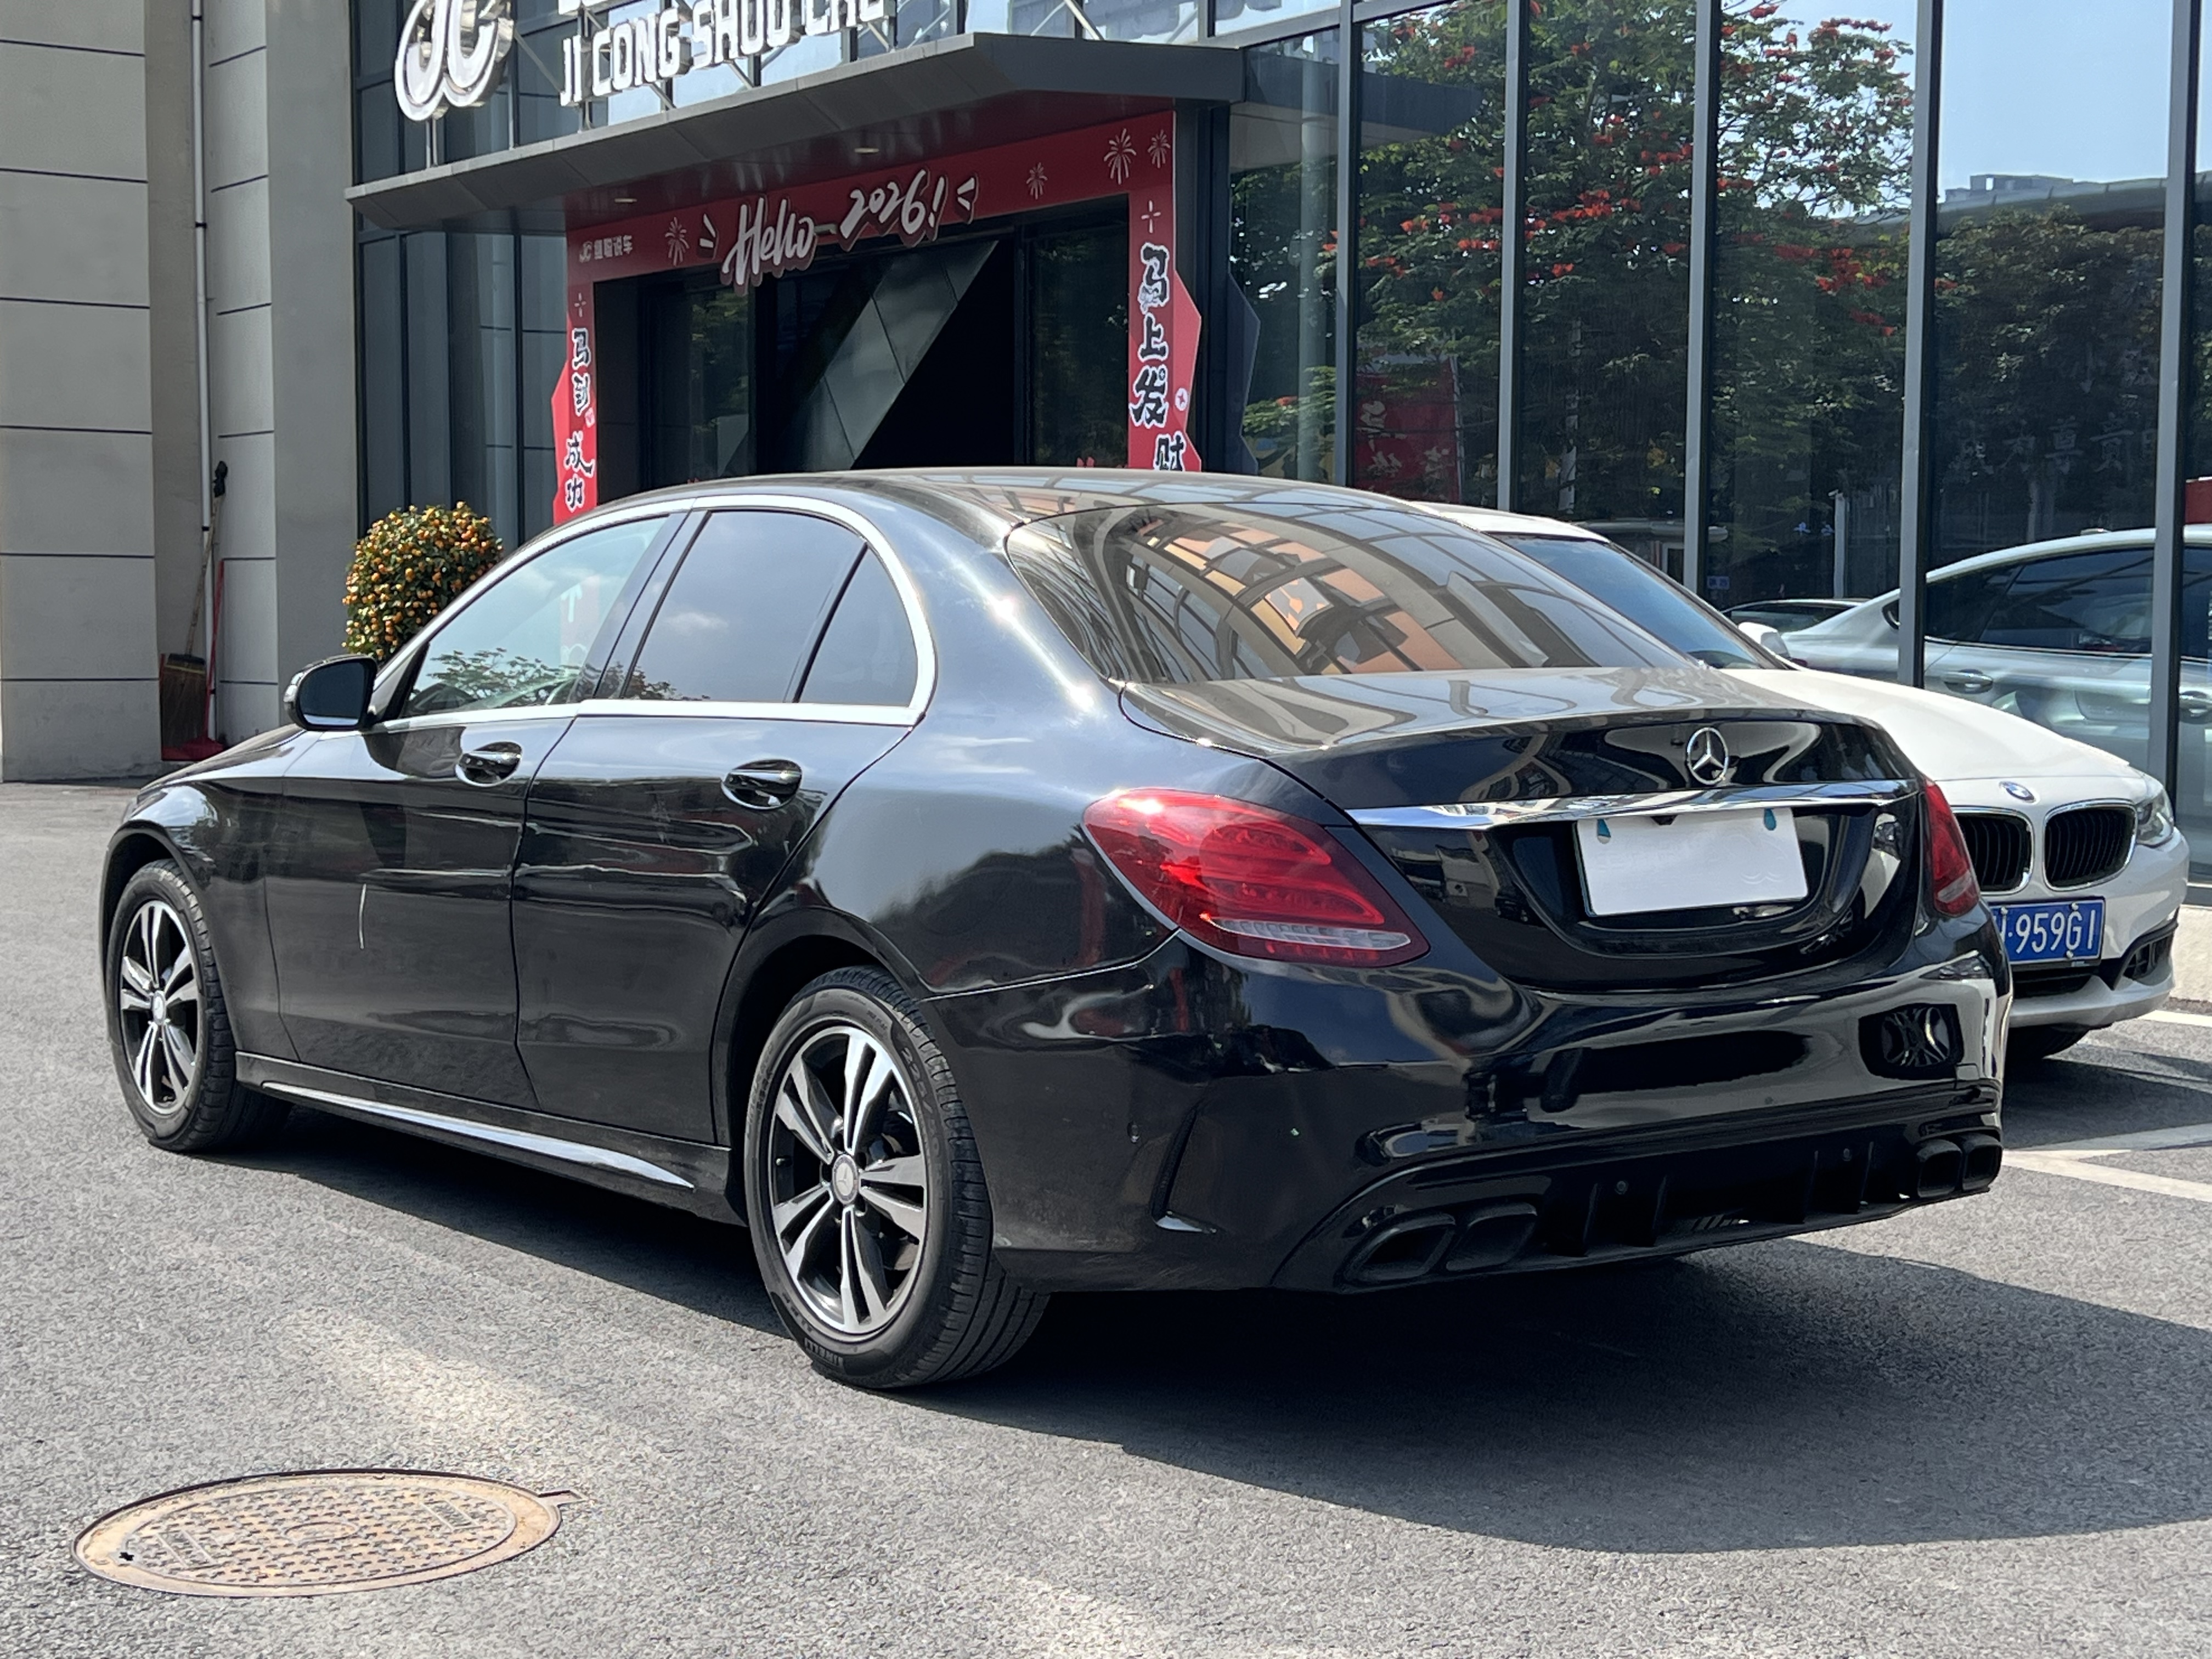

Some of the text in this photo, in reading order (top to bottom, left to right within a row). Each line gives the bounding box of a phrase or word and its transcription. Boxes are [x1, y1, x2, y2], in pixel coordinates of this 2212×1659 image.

[560, 34, 583, 107] JI
[592, 8, 680, 97] CONG
[721, 169, 945, 285] Hello 2026!
